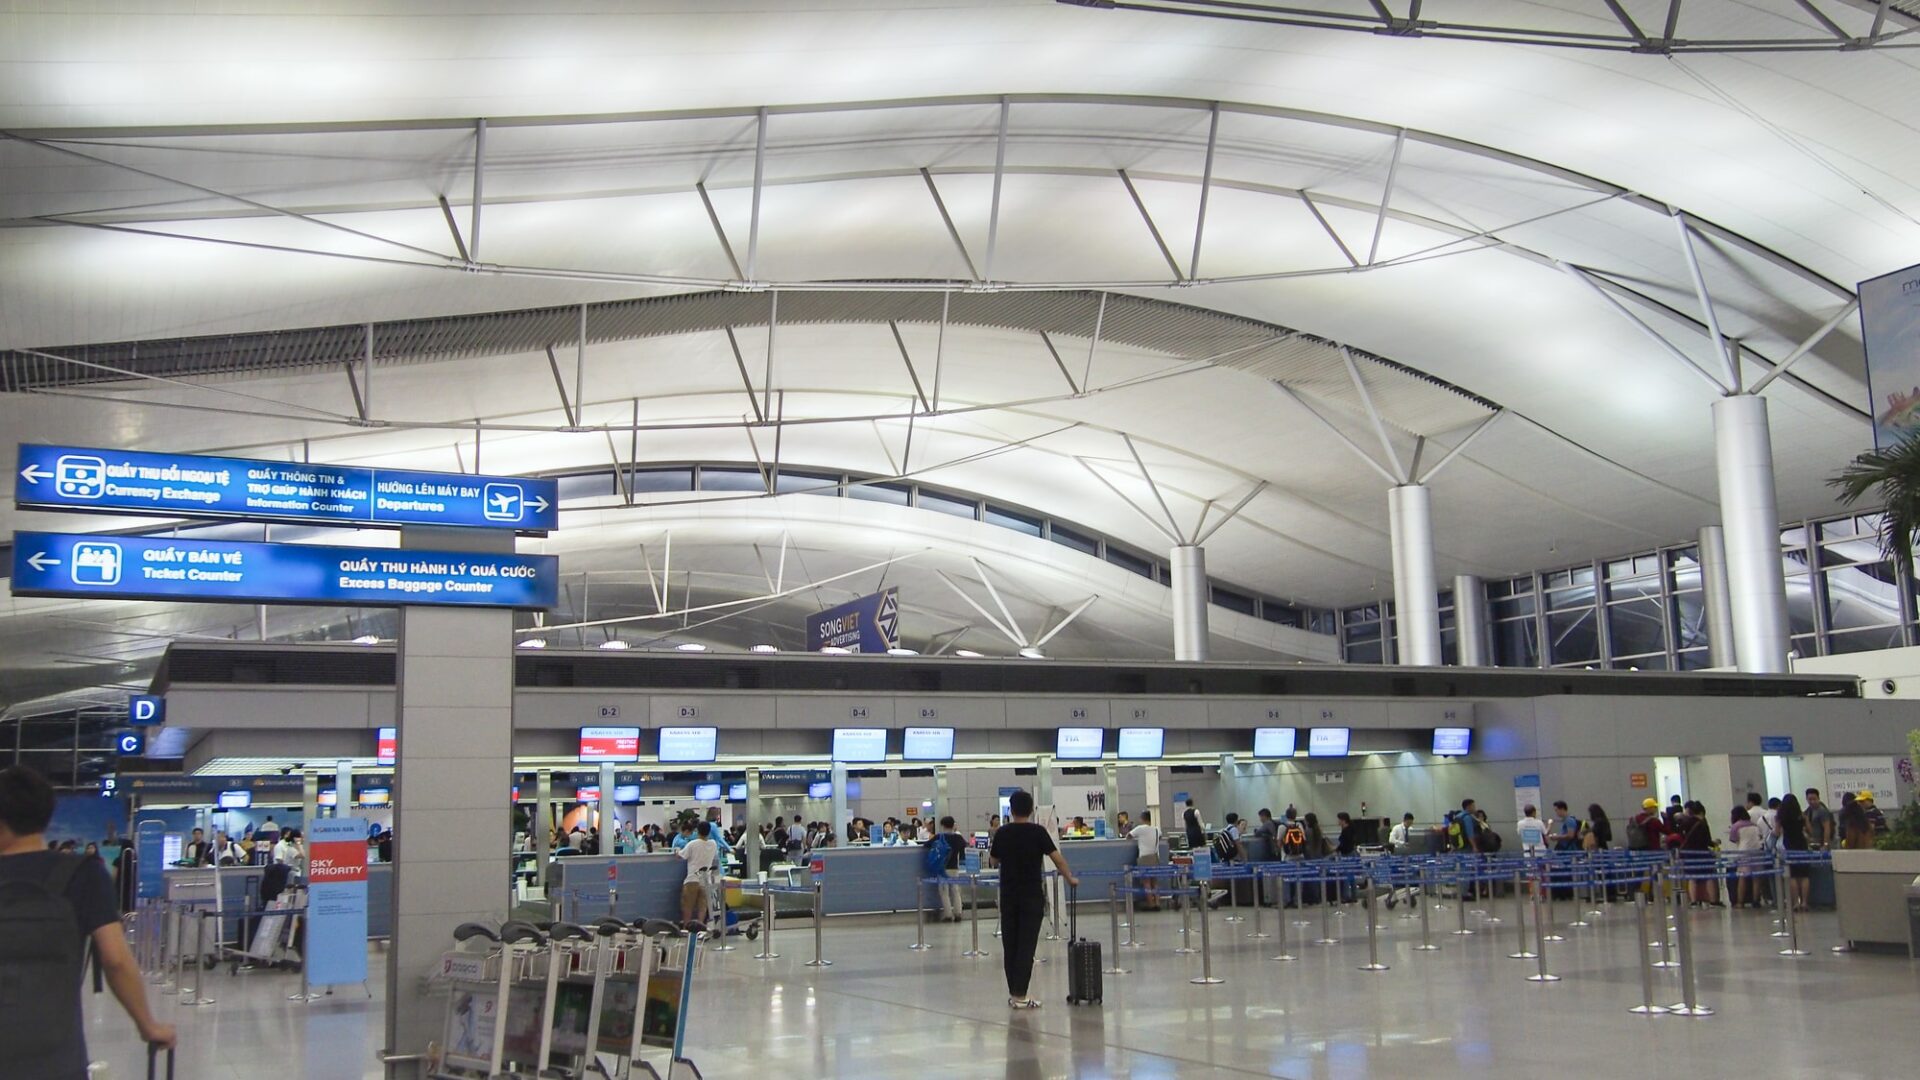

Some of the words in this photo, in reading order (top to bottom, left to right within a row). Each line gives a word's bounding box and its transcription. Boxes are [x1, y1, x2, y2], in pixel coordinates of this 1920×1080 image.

[280, 471, 316, 483] THÔNG
[318, 474, 335, 484] TIN
[336, 476, 345, 485] &
[106, 483, 161, 501] Currency
[162, 487, 221, 504] Exchange
[246, 483, 271, 495] TRỢ
[271, 484, 298, 496] GIÚP
[298, 485, 328, 497] HÀNH
[330, 488, 367, 500] KHÁCH
[415, 482, 436, 496] LÊN
[437, 484, 459, 497] MÁY
[460, 487, 480, 498] BAY
[246, 497, 309, 510] Information
[311, 501, 354, 513] Counter
[377, 497, 445, 512] Departures
[188, 549, 220, 564] BÁN
[222, 551, 243, 565] VÉ
[142, 567, 186, 580] Ticket
[187, 568, 243, 582] Counter
[380, 562, 407, 574] THU
[410, 562, 448, 575] HÀNH
[451, 563, 467, 576] LÝ
[470, 563, 498, 577] QUÁ
[500, 565, 536, 578] CƯỚC
[339, 576, 385, 589] Excess
[388, 578, 443, 593] Baggage
[445, 581, 494, 592] Counter
[136, 700, 155, 720] D
[602, 708, 617, 716] D-2
[681, 708, 696, 716] D-3
[853, 709, 866, 717] D-4
[922, 709, 935, 717] D-5
[121, 736, 138, 752] C
[310, 859, 334, 868] SKY
[310, 866, 363, 876] PRIORITY
